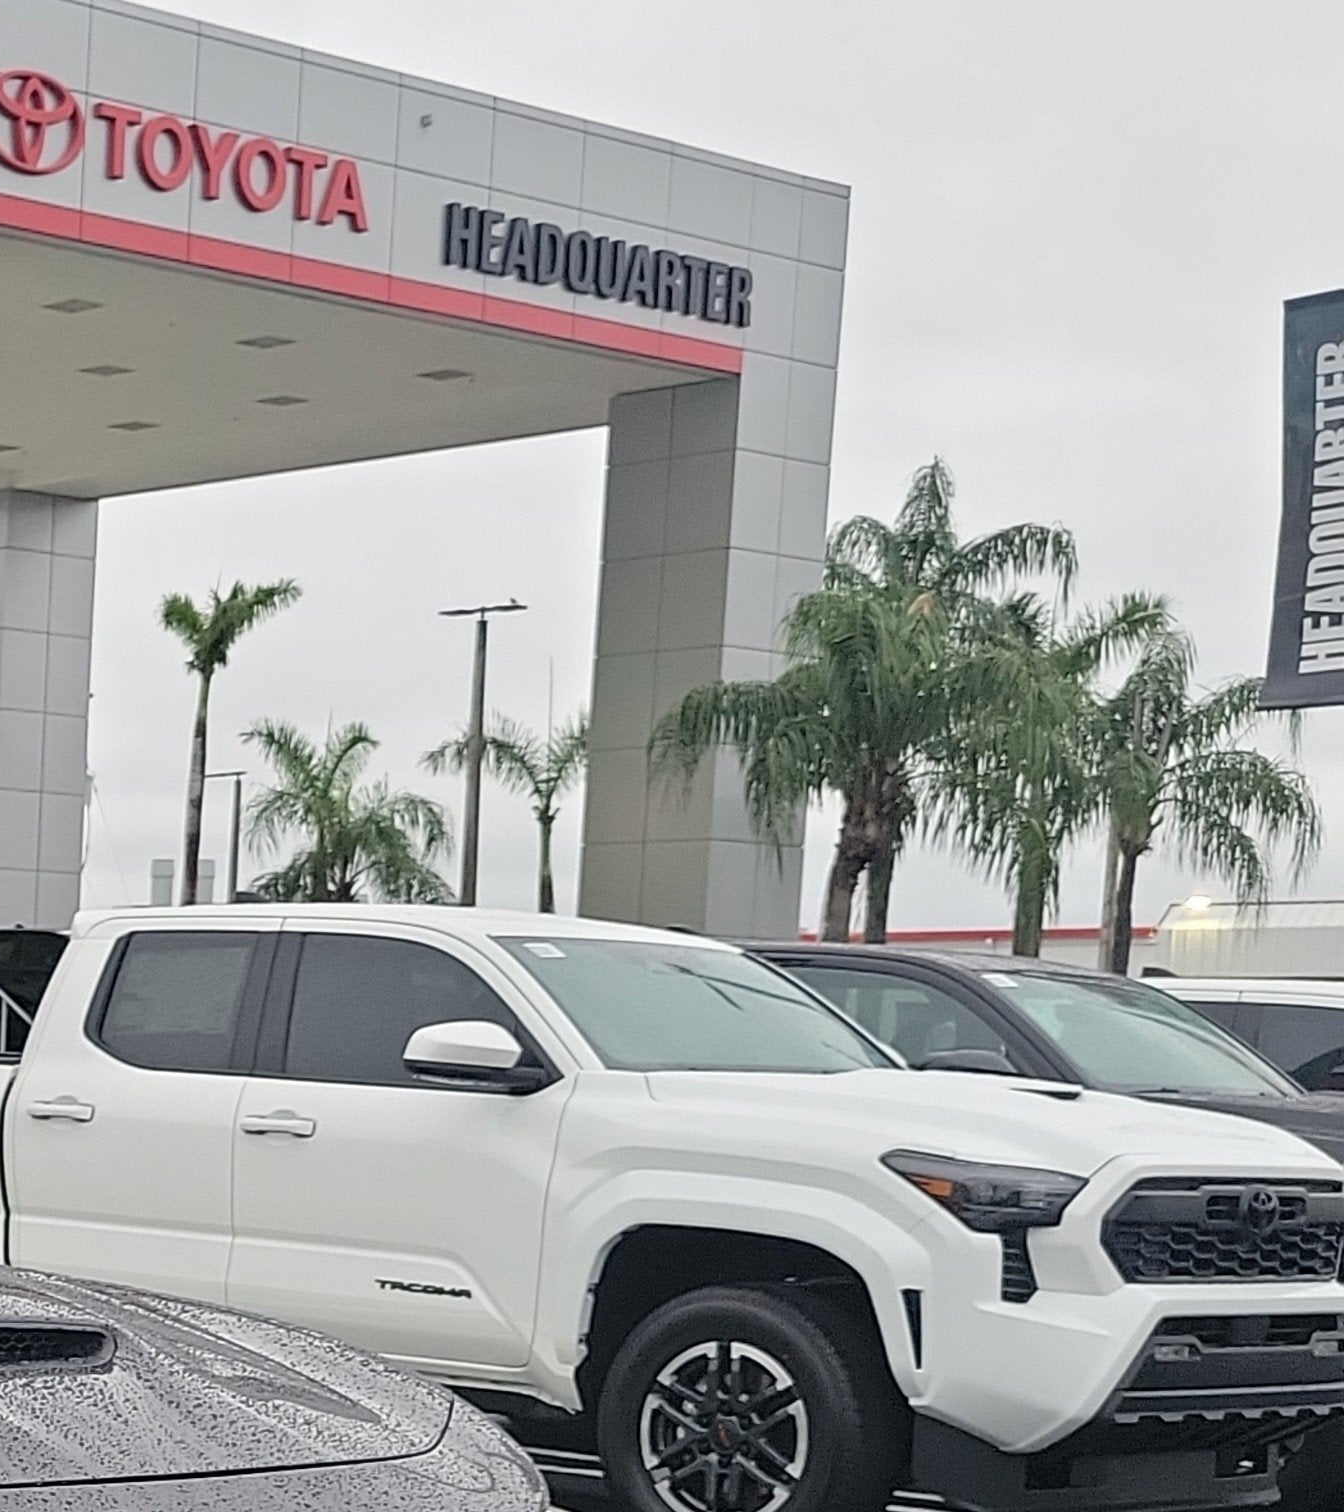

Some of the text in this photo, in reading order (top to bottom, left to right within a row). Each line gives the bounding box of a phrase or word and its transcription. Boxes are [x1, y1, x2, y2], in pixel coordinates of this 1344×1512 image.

[94, 102, 369, 232] TOYOTA
[445, 203, 753, 327] HEADQUARTER
[374, 1279, 472, 1299] TACOMA
